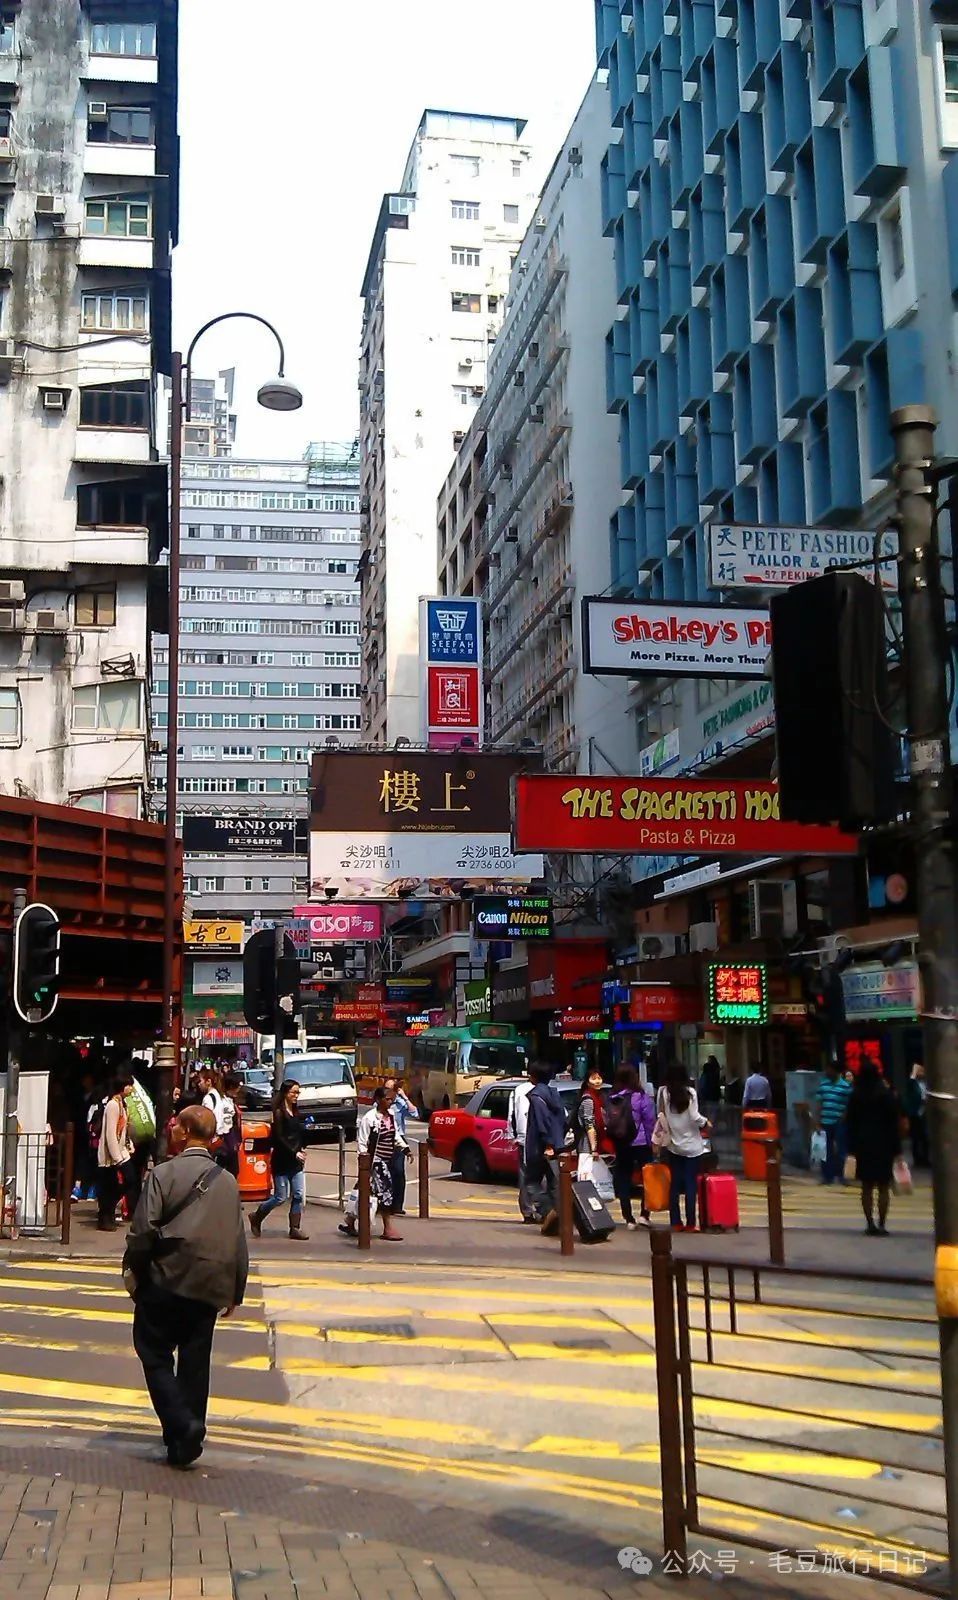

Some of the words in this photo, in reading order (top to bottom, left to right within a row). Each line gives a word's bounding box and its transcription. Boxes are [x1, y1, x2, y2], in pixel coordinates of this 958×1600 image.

[748, 553, 802, 568] TAILOR
[811, 556, 820, 568] &
[765, 570, 777, 579] 57
[612, 614, 740, 648] Shakey's
[431, 640, 474, 648] SEEFAH
[630, 651, 660, 661] More
[704, 654, 733, 664] More
[738, 655, 765, 665] Than
[379, 770, 471, 813] 樓上
[561, 787, 613, 818] THE
[215, 820, 265, 830] BRAND
[268, 821, 297, 831] OFF
[640, 828, 679, 845] Pasta
[683, 830, 695, 844] &
[700, 830, 736, 845] Pizza
[345, 845, 393, 858] 尖沙咀1
[353, 860, 376, 869] 2721
[379, 860, 400, 869] 1611
[469, 860, 492, 869] 2736
[494, 860, 516, 869] 6001
[521, 900, 533, 908] TAX
[534, 900, 548, 908] FREE
[478, 912, 508, 924] Canon
[509, 912, 548, 924] Nikon
[521, 928, 533, 936] TAX
